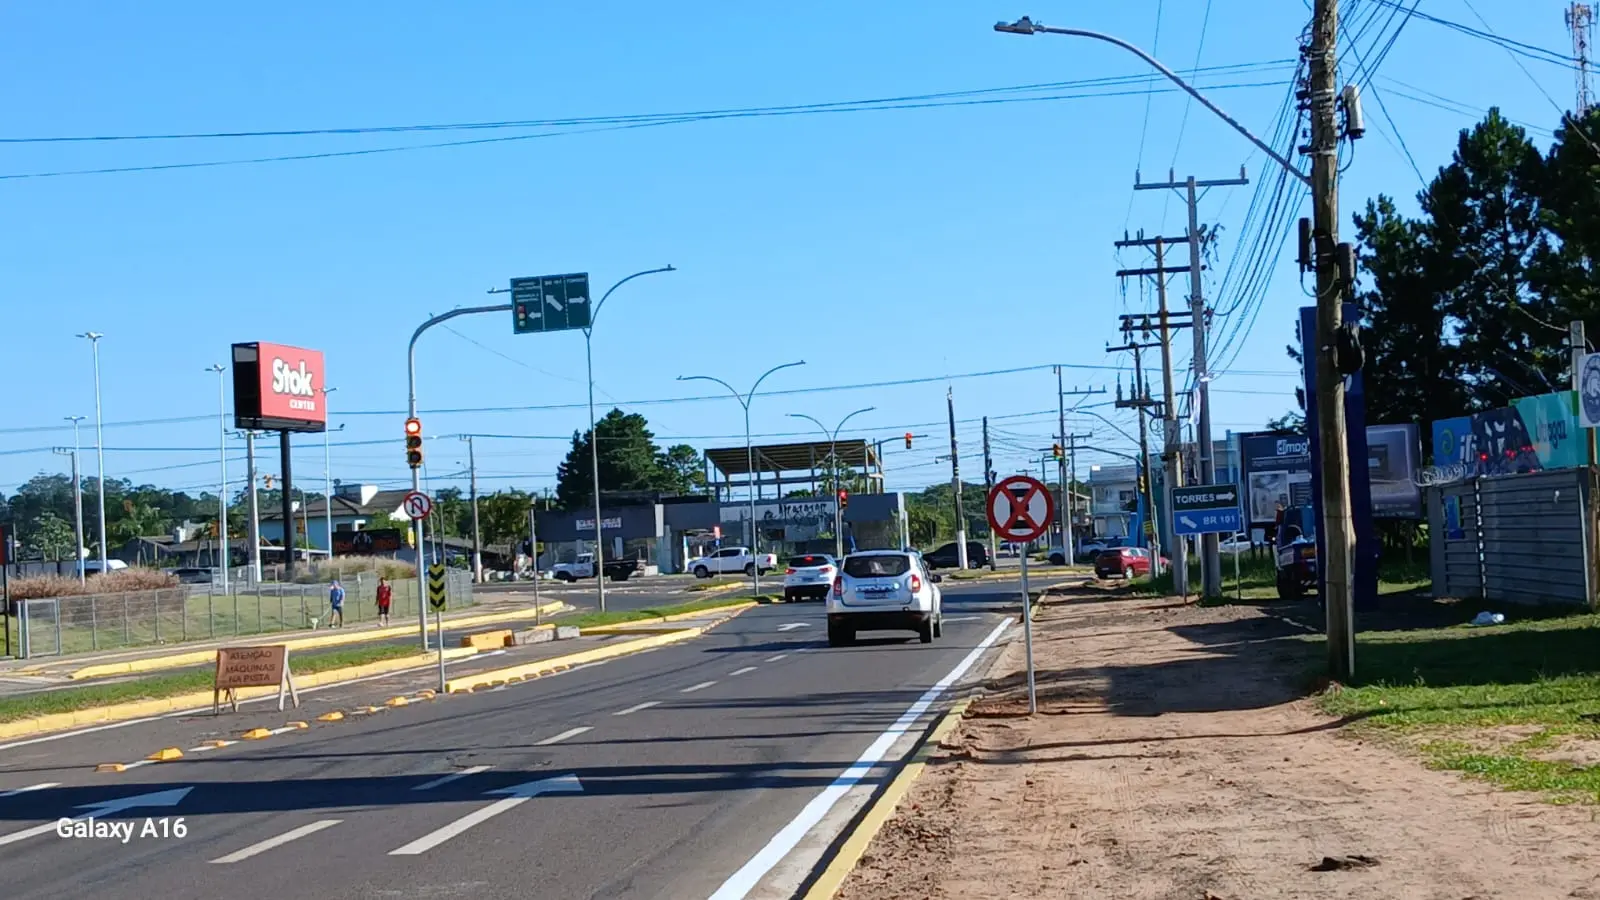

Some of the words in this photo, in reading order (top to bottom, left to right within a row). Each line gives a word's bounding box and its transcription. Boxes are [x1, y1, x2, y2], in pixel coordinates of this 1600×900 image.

[272, 357, 315, 398] Stok
[1175, 493, 1215, 504] TORRES
[1203, 515, 1218, 525] BR
[1220, 514, 1236, 524] 101
[230, 650, 273, 660] ATENÇÃO
[226, 663, 276, 673] MÁQUINAS
[229, 675, 242, 684] NA
[243, 673, 271, 683] PISTA
